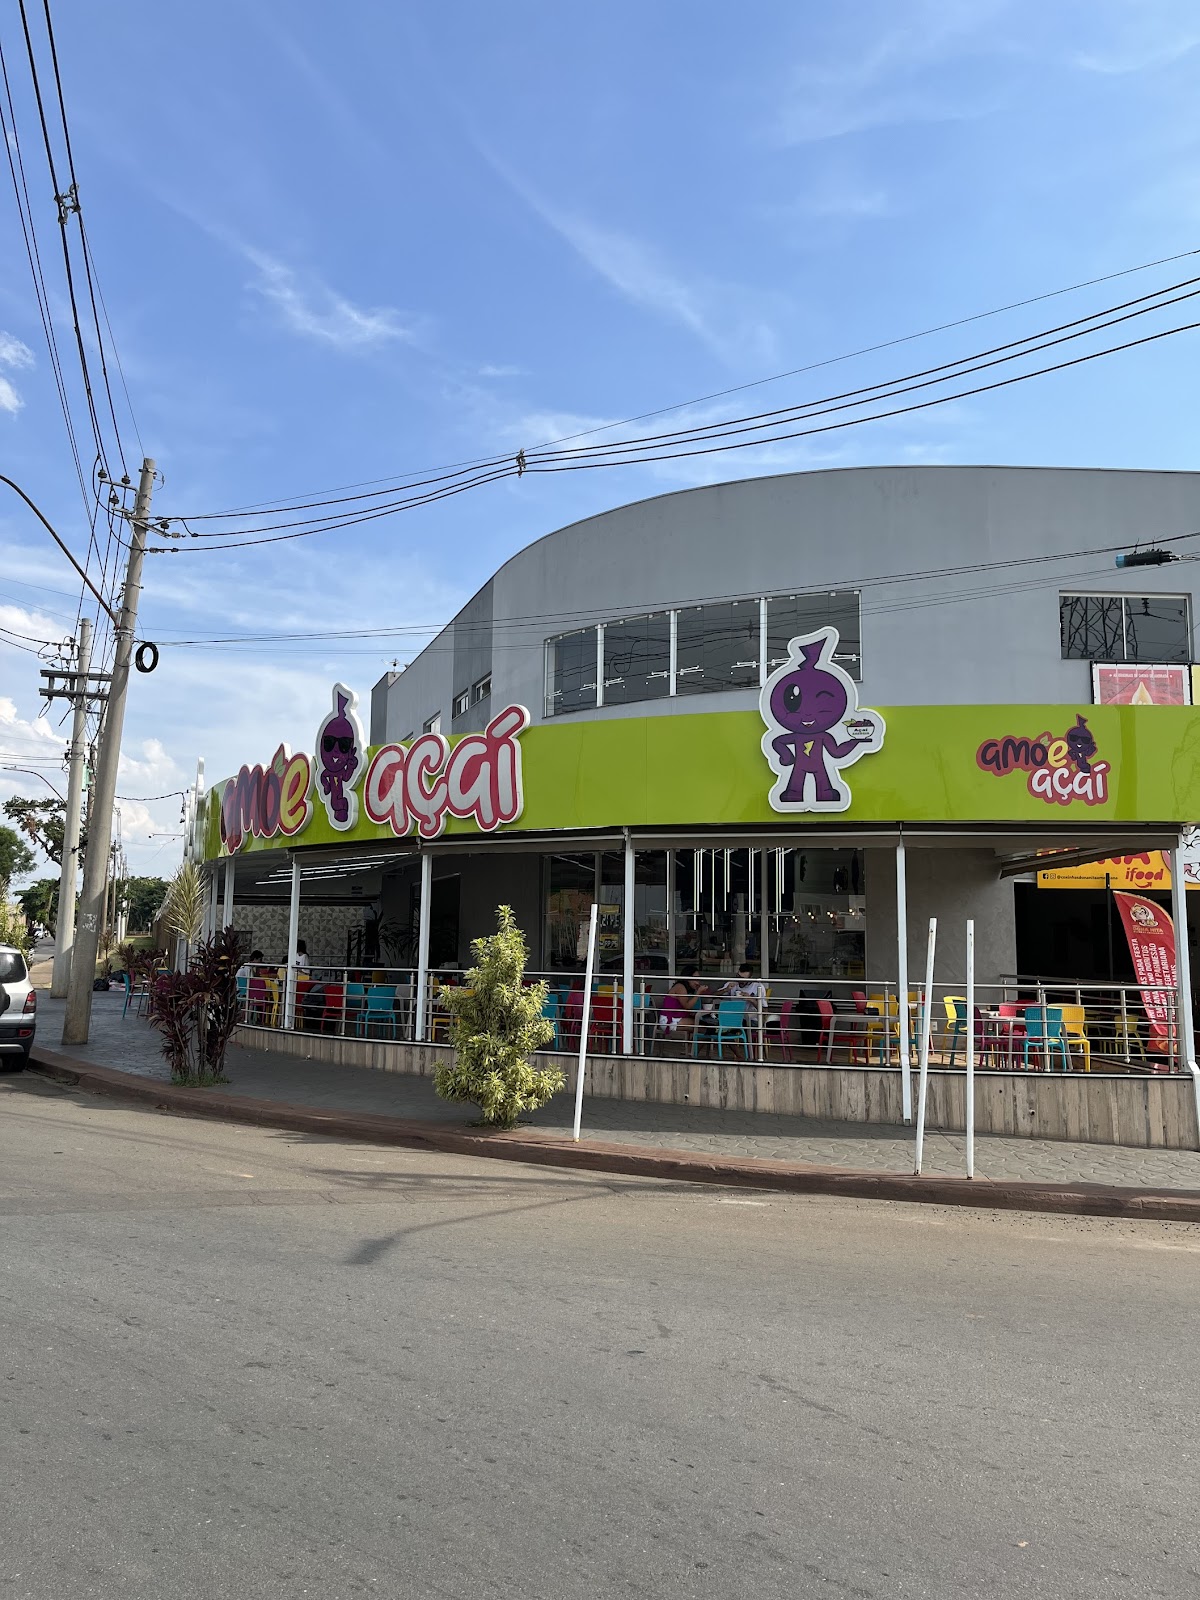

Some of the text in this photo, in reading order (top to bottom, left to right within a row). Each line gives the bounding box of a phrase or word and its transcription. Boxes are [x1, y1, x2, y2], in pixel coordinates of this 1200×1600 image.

[366, 706, 526, 836] açaí
[1031, 763, 1107, 800] açaí
[1131, 938, 1141, 958] FESTA
[1158, 946, 1172, 987] EGETARIANA
[1136, 958, 1146, 976] PARA
